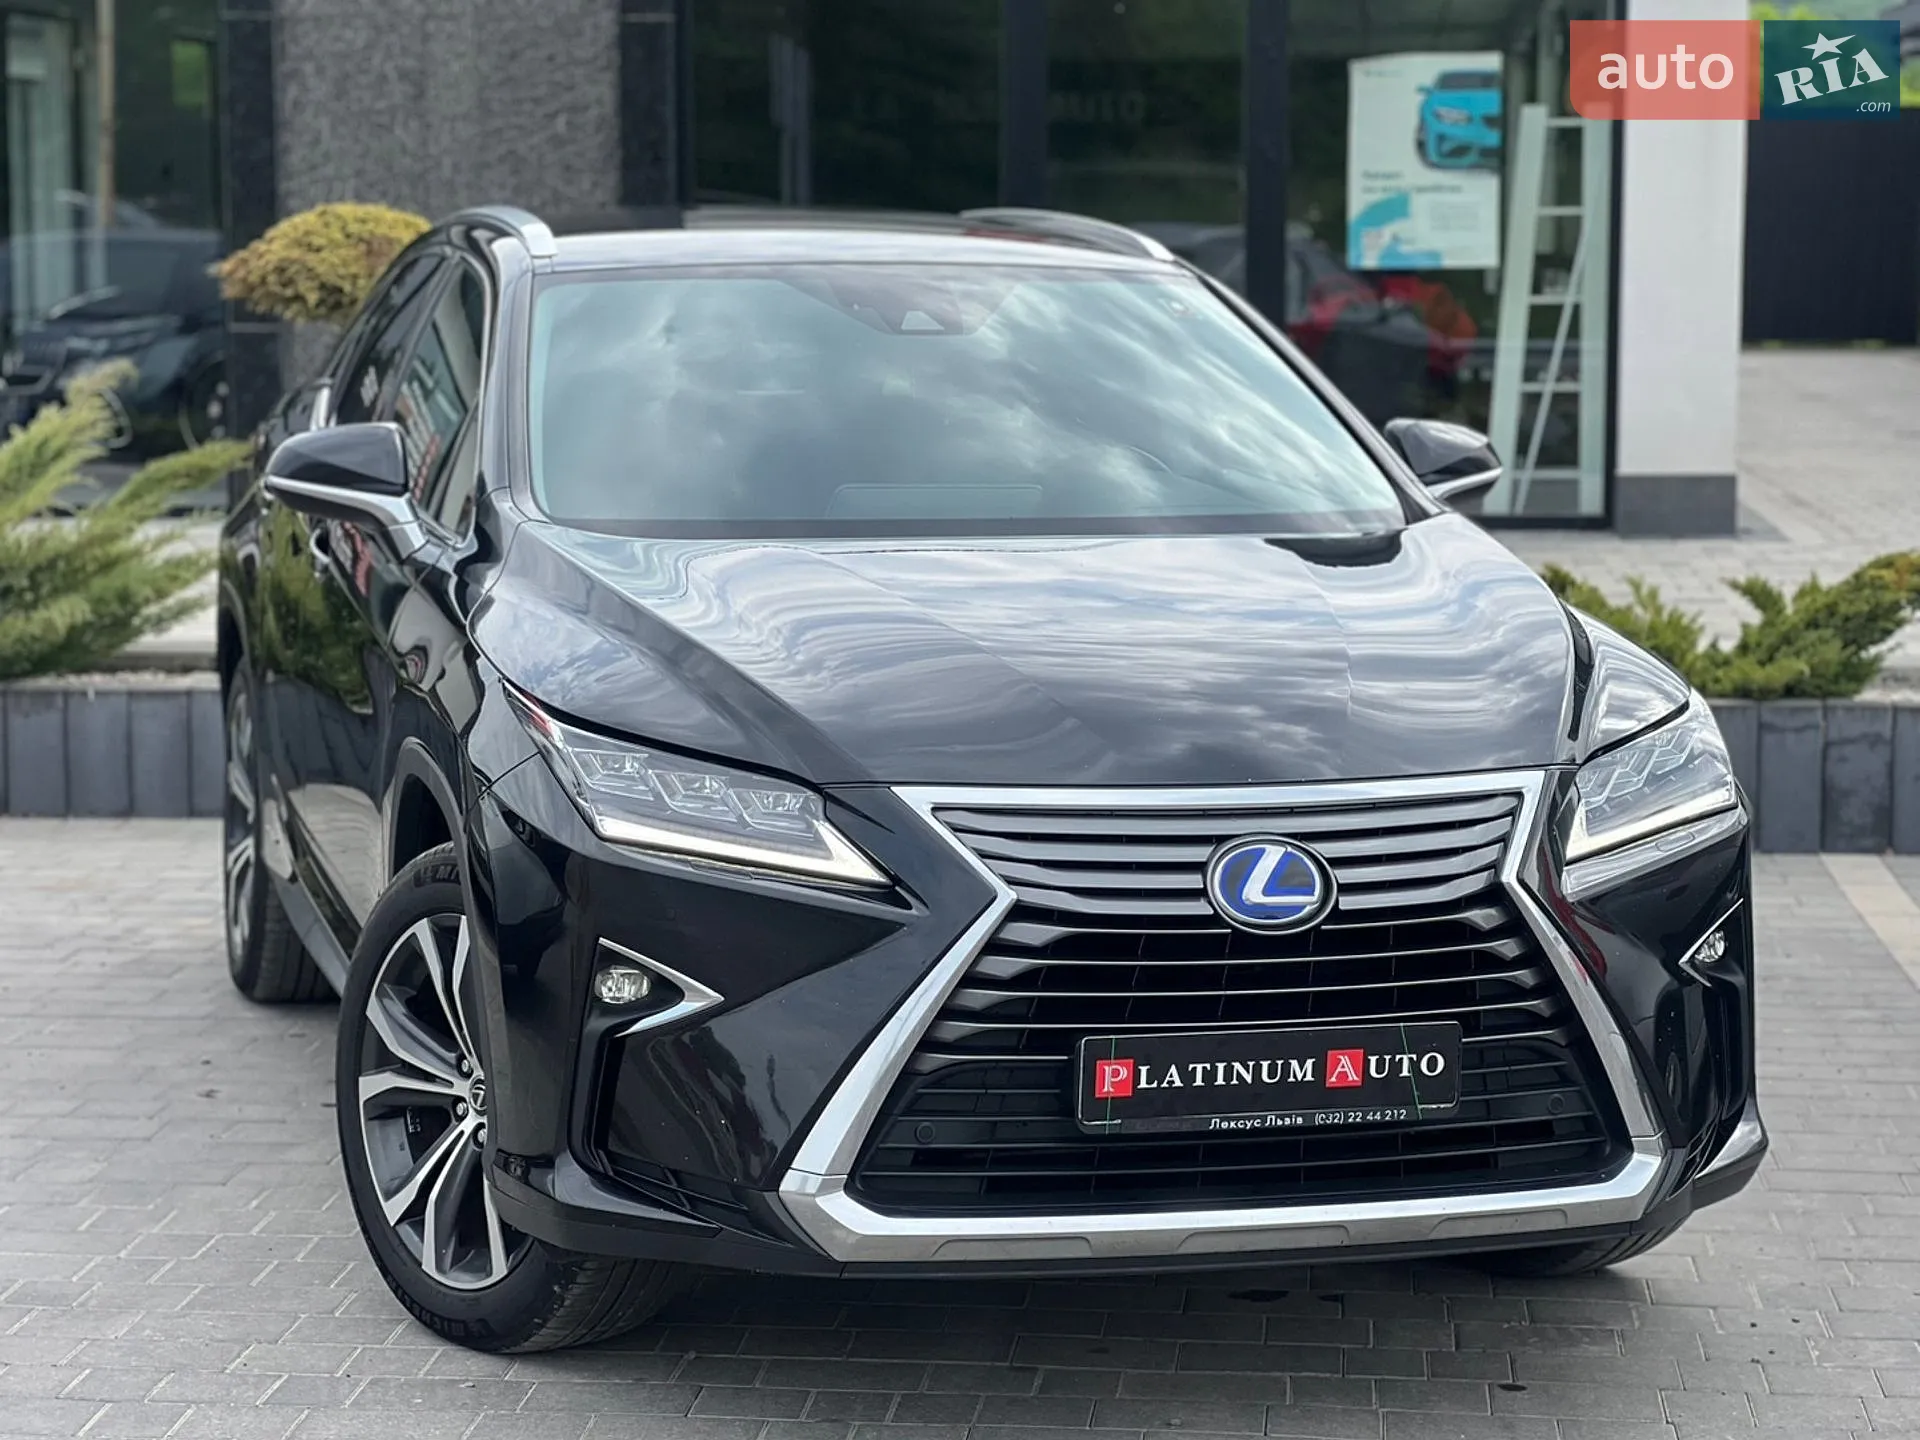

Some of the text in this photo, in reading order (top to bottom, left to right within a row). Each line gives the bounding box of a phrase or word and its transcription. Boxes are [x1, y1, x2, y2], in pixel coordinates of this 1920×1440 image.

[1101, 1051, 1446, 1094] PLATINUM AUTO
[1314, 1111, 1344, 1126] (032)
[1347, 1111, 1363, 1123] 22
[1366, 1111, 1381, 1121] 44
[1384, 1109, 1407, 1121] 212
